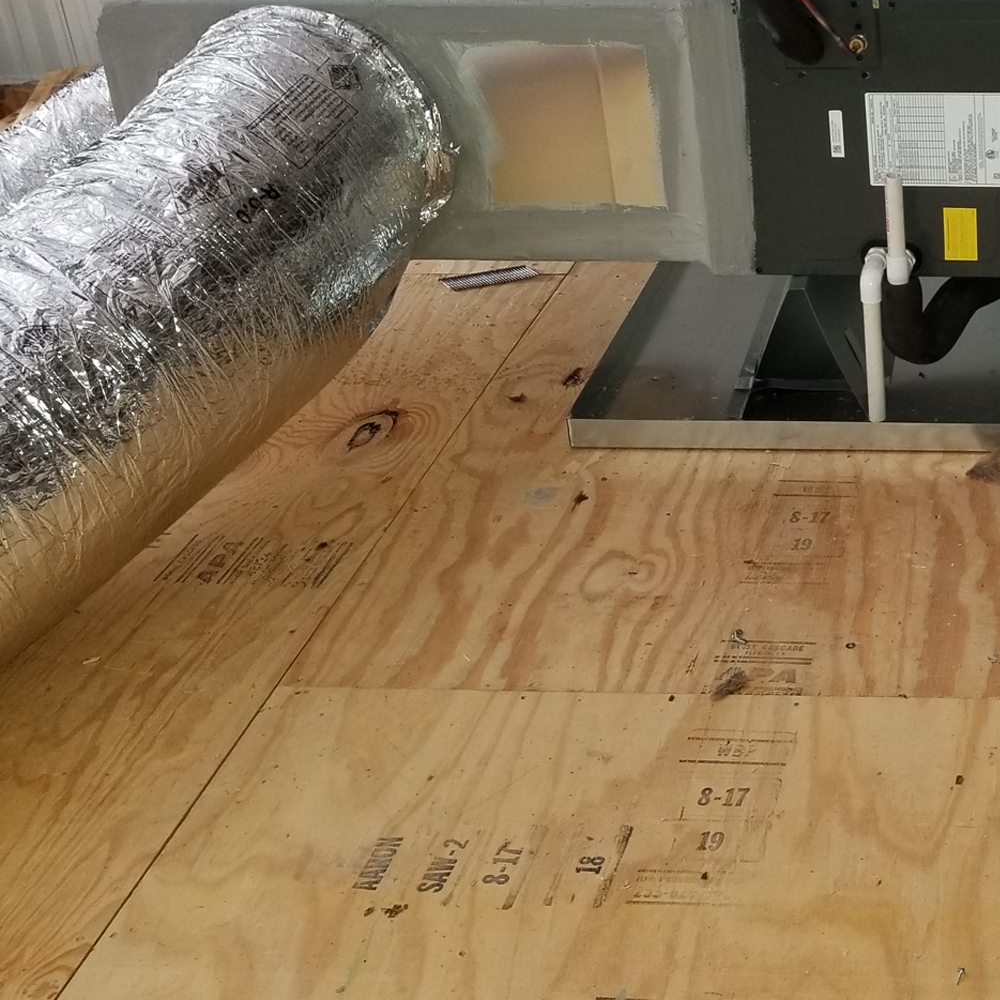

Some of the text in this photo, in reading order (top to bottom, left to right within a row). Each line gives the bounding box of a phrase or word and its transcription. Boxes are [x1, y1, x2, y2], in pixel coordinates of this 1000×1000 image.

[789, 510, 831, 524] 8-17
[790, 538, 813, 551] 19
[697, 786, 751, 807] 8-17
[695, 830, 726, 852] 19
[352, 836, 405, 891] AARON
[416, 838, 470, 893] SAW-2
[481, 843, 525, 886] 8-17
[575, 855, 606, 875] 18
